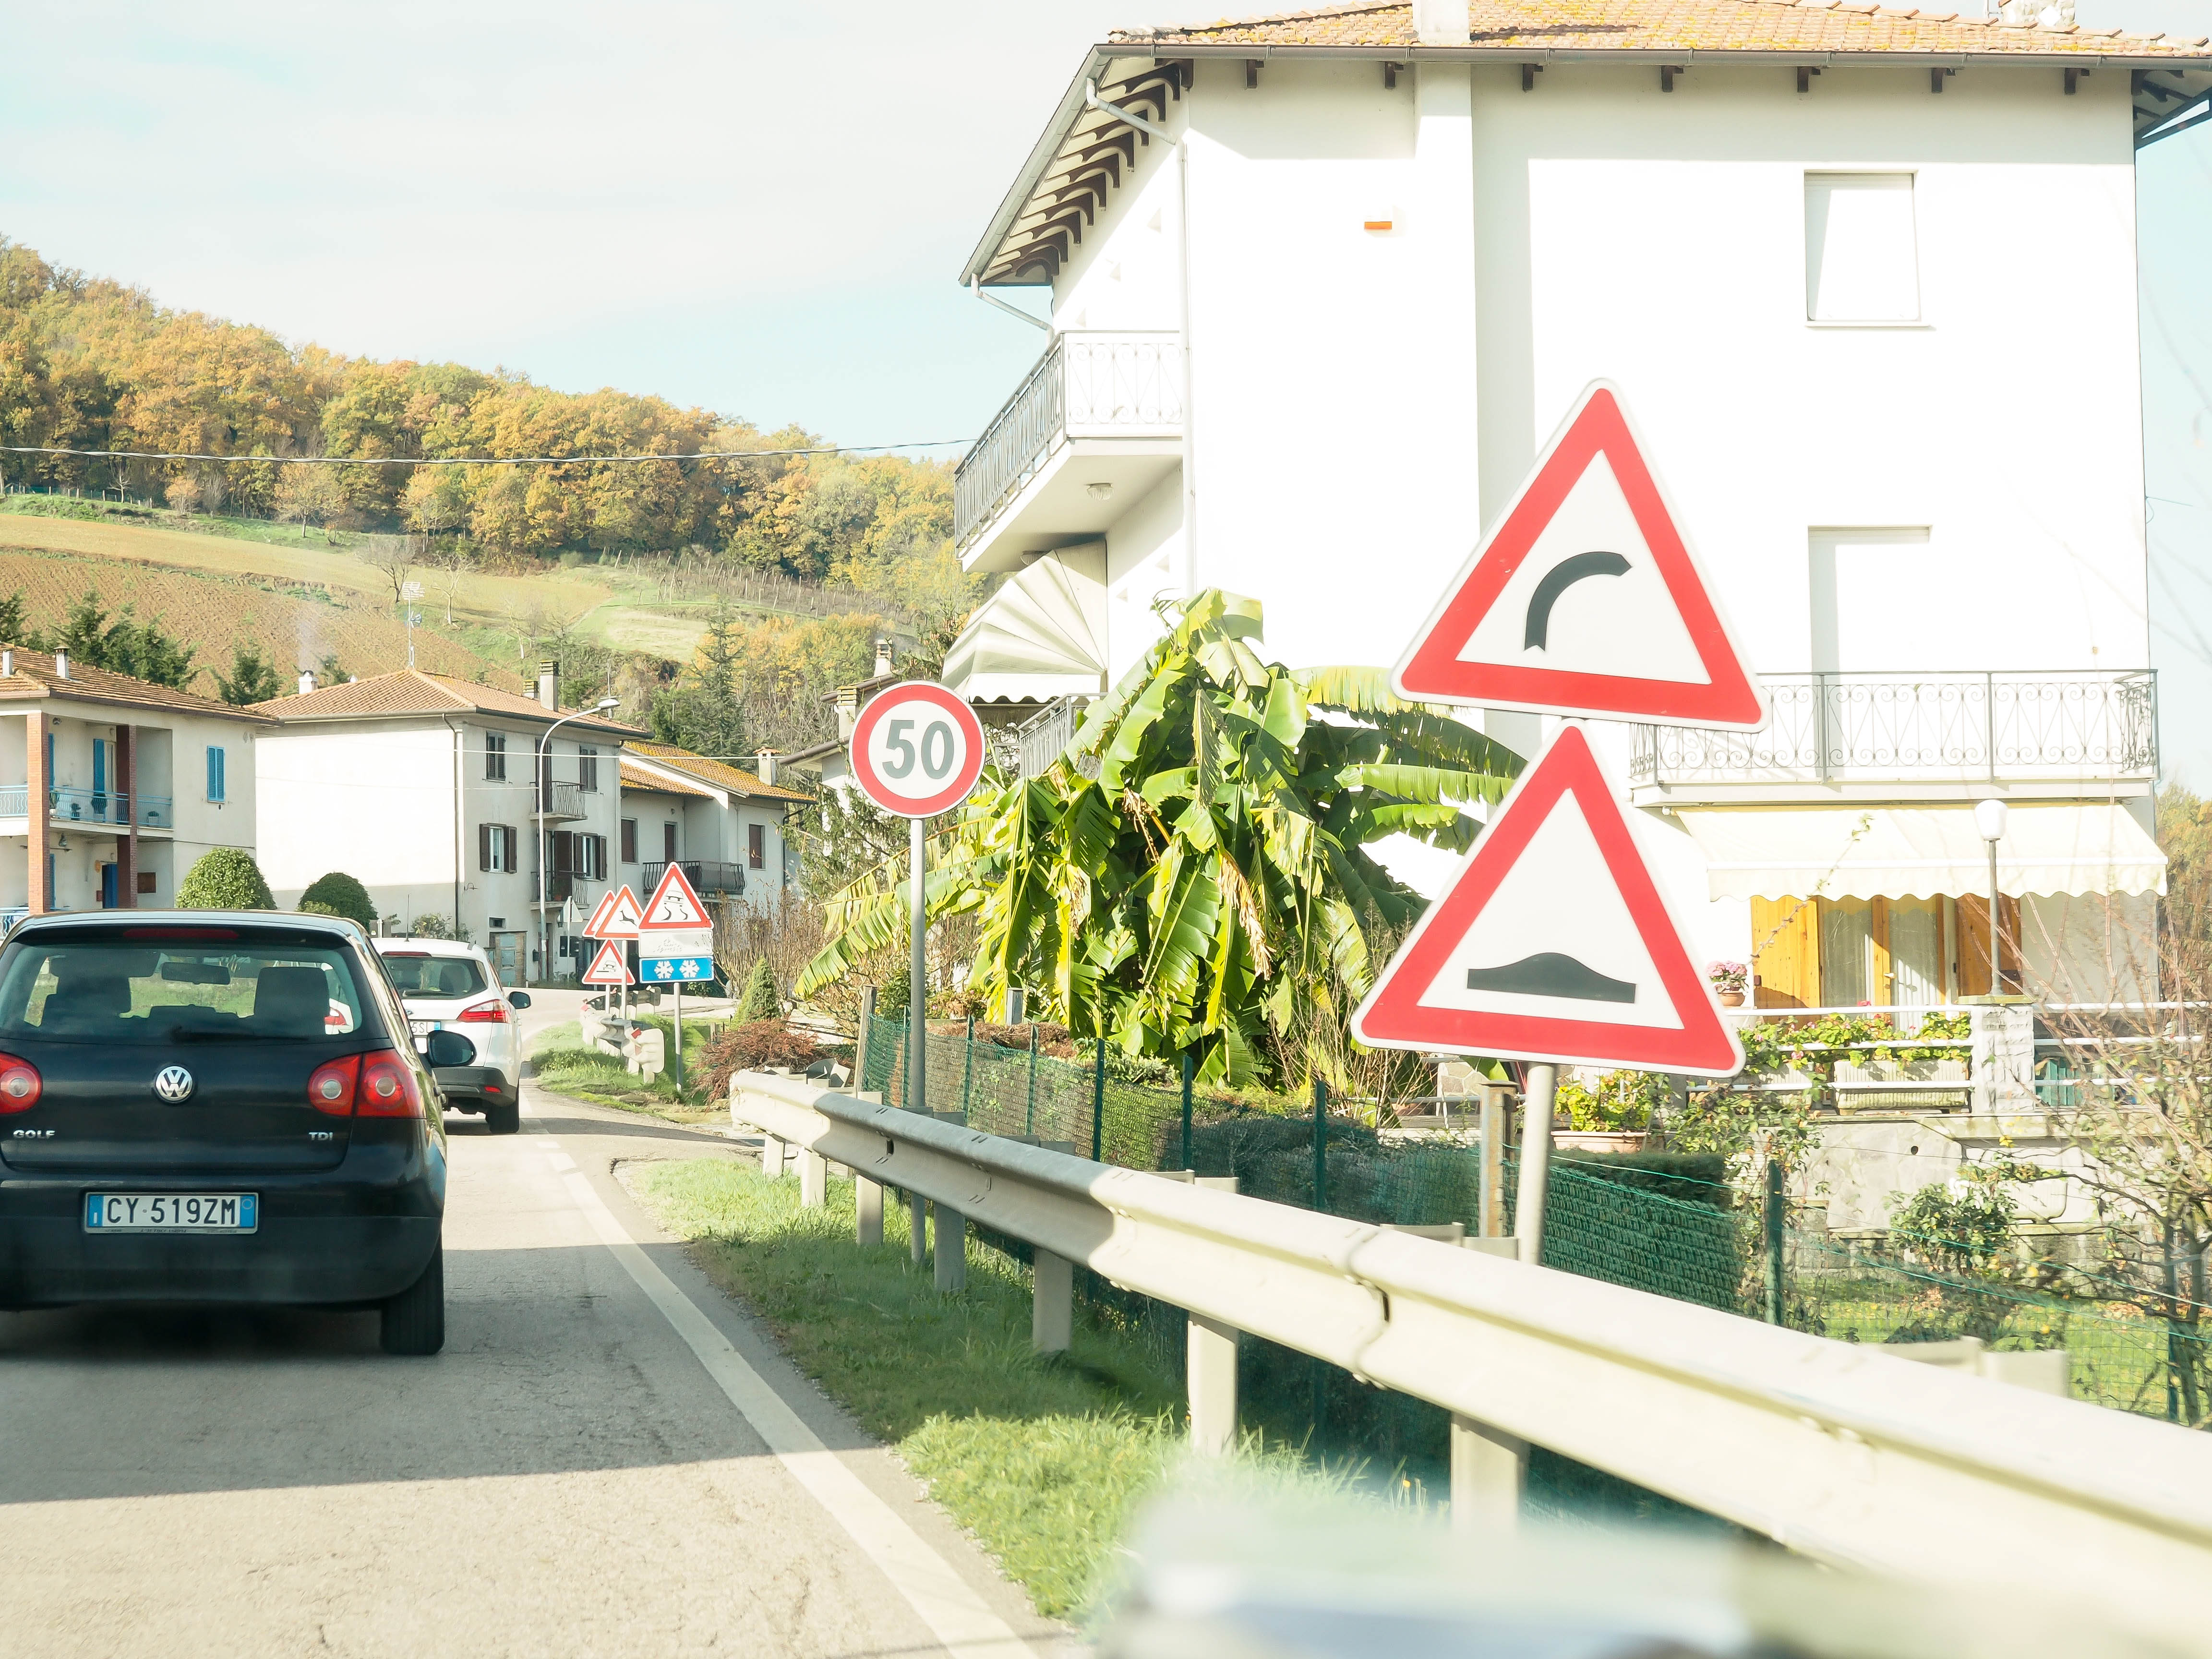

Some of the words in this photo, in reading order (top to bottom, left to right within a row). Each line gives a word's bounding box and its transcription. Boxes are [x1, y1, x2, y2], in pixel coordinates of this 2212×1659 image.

[882, 719, 954, 780] 50
[13, 1130, 56, 1139] GOLF
[309, 1132, 333, 1141] TDI
